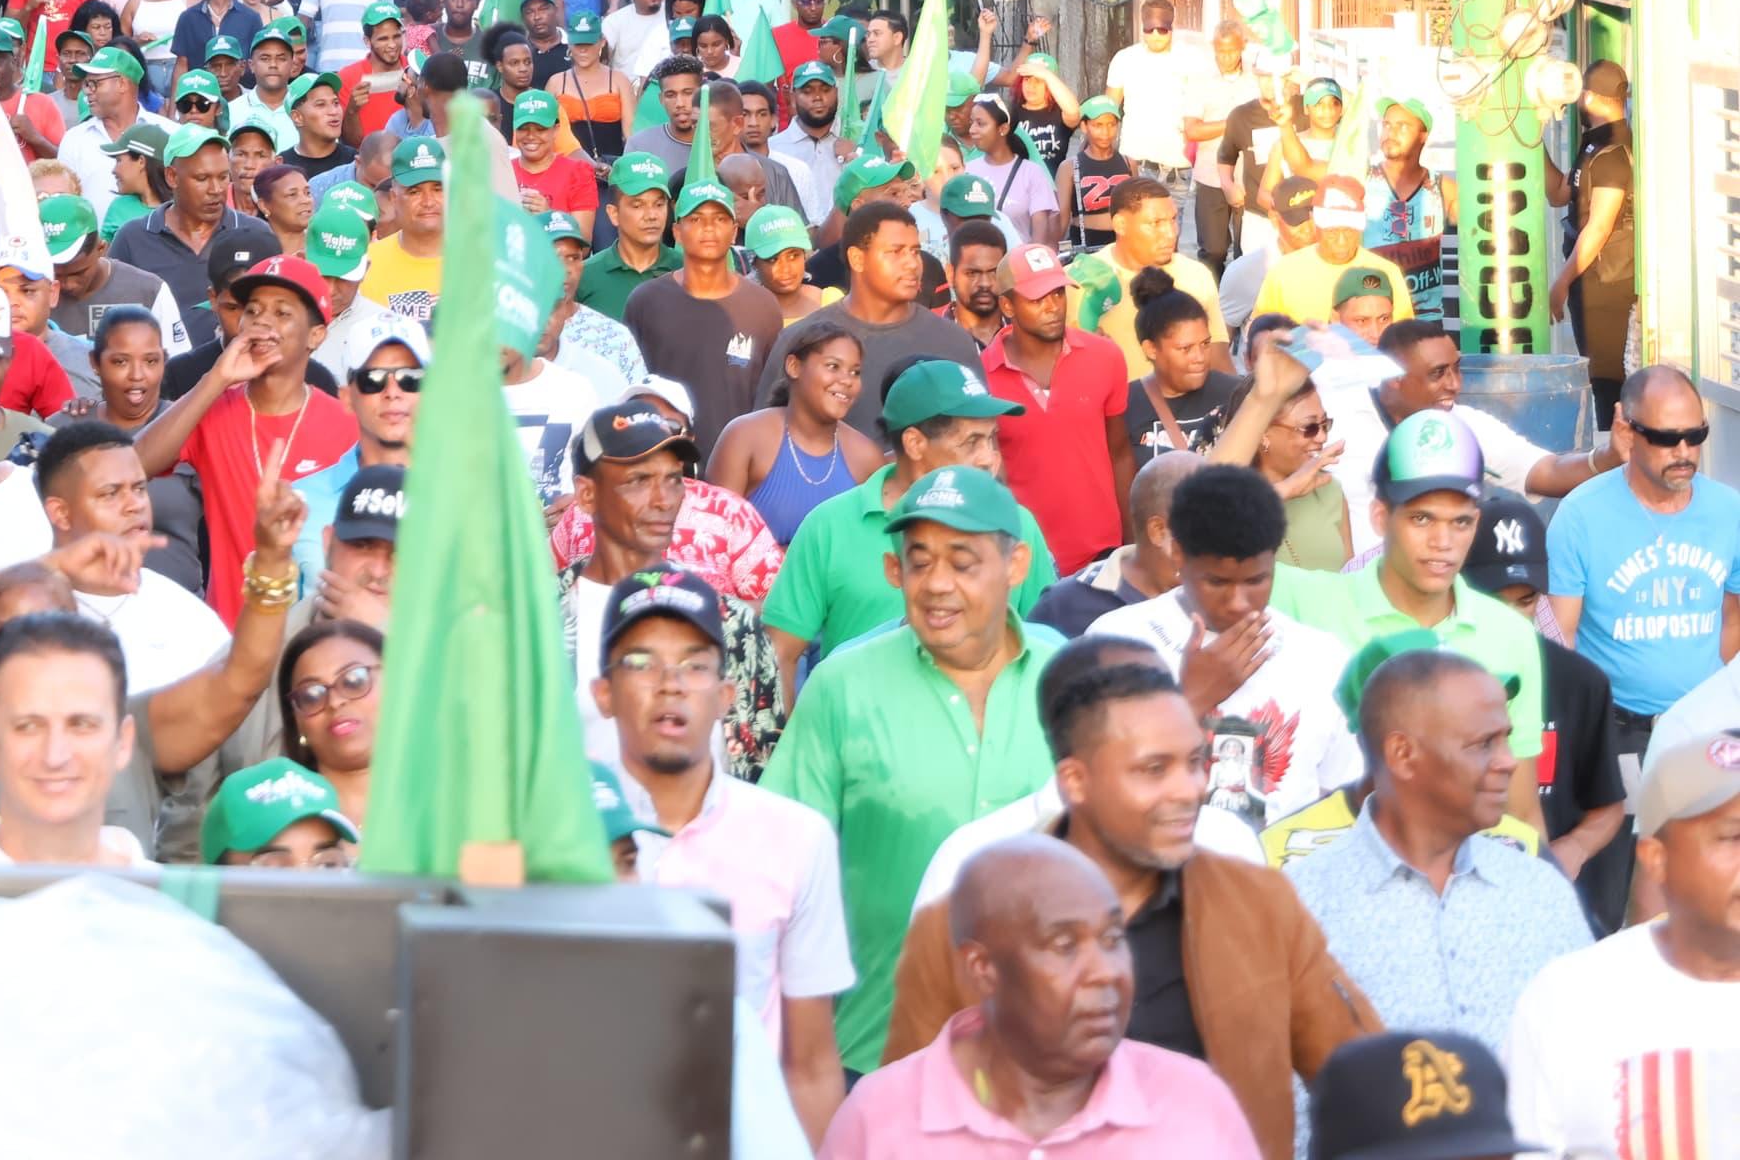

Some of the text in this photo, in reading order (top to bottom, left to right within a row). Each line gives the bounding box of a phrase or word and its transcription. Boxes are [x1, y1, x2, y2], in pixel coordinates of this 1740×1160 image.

[915, 491, 966, 507] LEONEL
[1605, 544, 1659, 595] TIMES
[1652, 575, 1687, 608] NY
